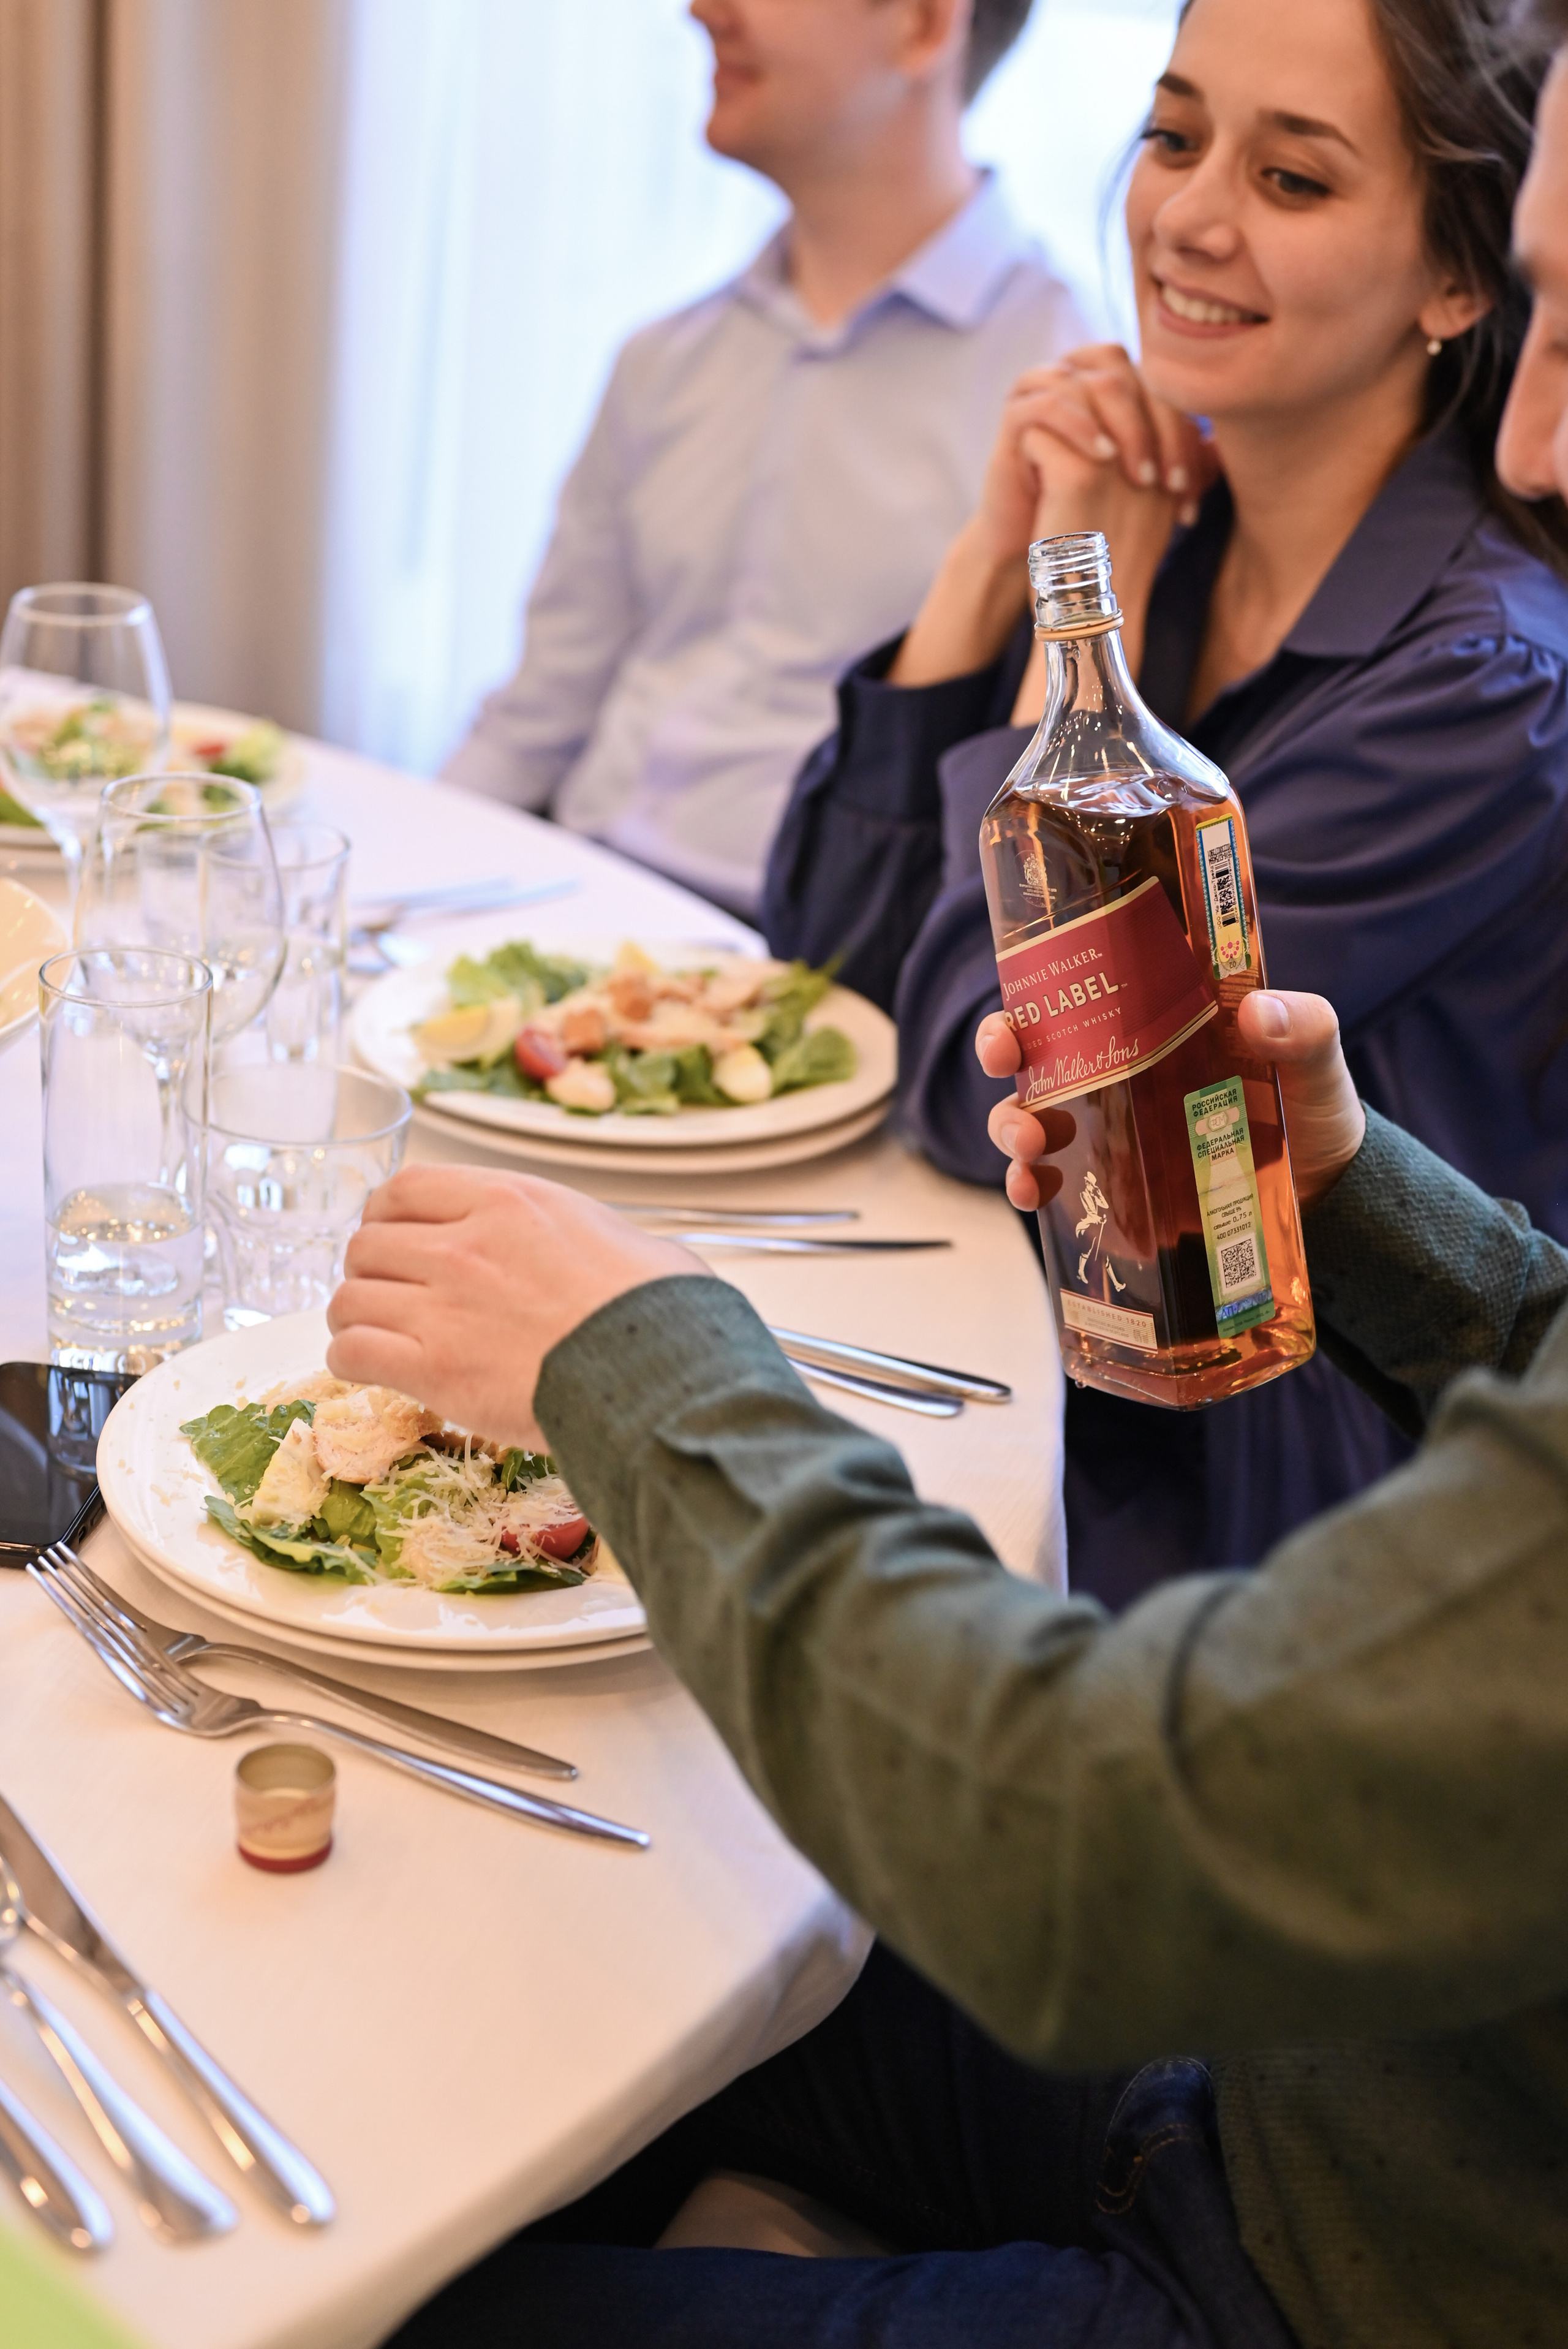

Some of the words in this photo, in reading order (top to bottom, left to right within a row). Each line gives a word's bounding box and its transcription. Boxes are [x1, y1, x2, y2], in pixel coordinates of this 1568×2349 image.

[1003, 969, 1049, 1001] JOHNNIE
[1005, 1002, 1041, 1032] RED
[1047, 1024, 1078, 1042] SCOTCH
[1083, 1007, 1121, 1028] WHISKY
[1026, 1065, 1054, 1102] John
[1054, 1051, 1097, 1088] Walker
[1105, 1035, 1139, 1069] Sons
[1192, 1088, 1237, 1111] РОССИЙСКАЯ
[1193, 1095, 1238, 1117] ФЕДЕРАЦИЯ
[1196, 1127, 1244, 1151] ФЕДЕРАЛЬНАЯ
[1197, 1135, 1245, 1159] СПЕЦИАЛЬНАЯ
[1212, 1147, 1234, 1161] МАРКА
[1207, 1202, 1232, 1217] АЛКОГОЛЬНАЯ
[1233, 1211, 1247, 1222] 0,75
[1067, 1299, 1122, 1322] ESTABLISHED
[1126, 1317, 1147, 1328] 1820
